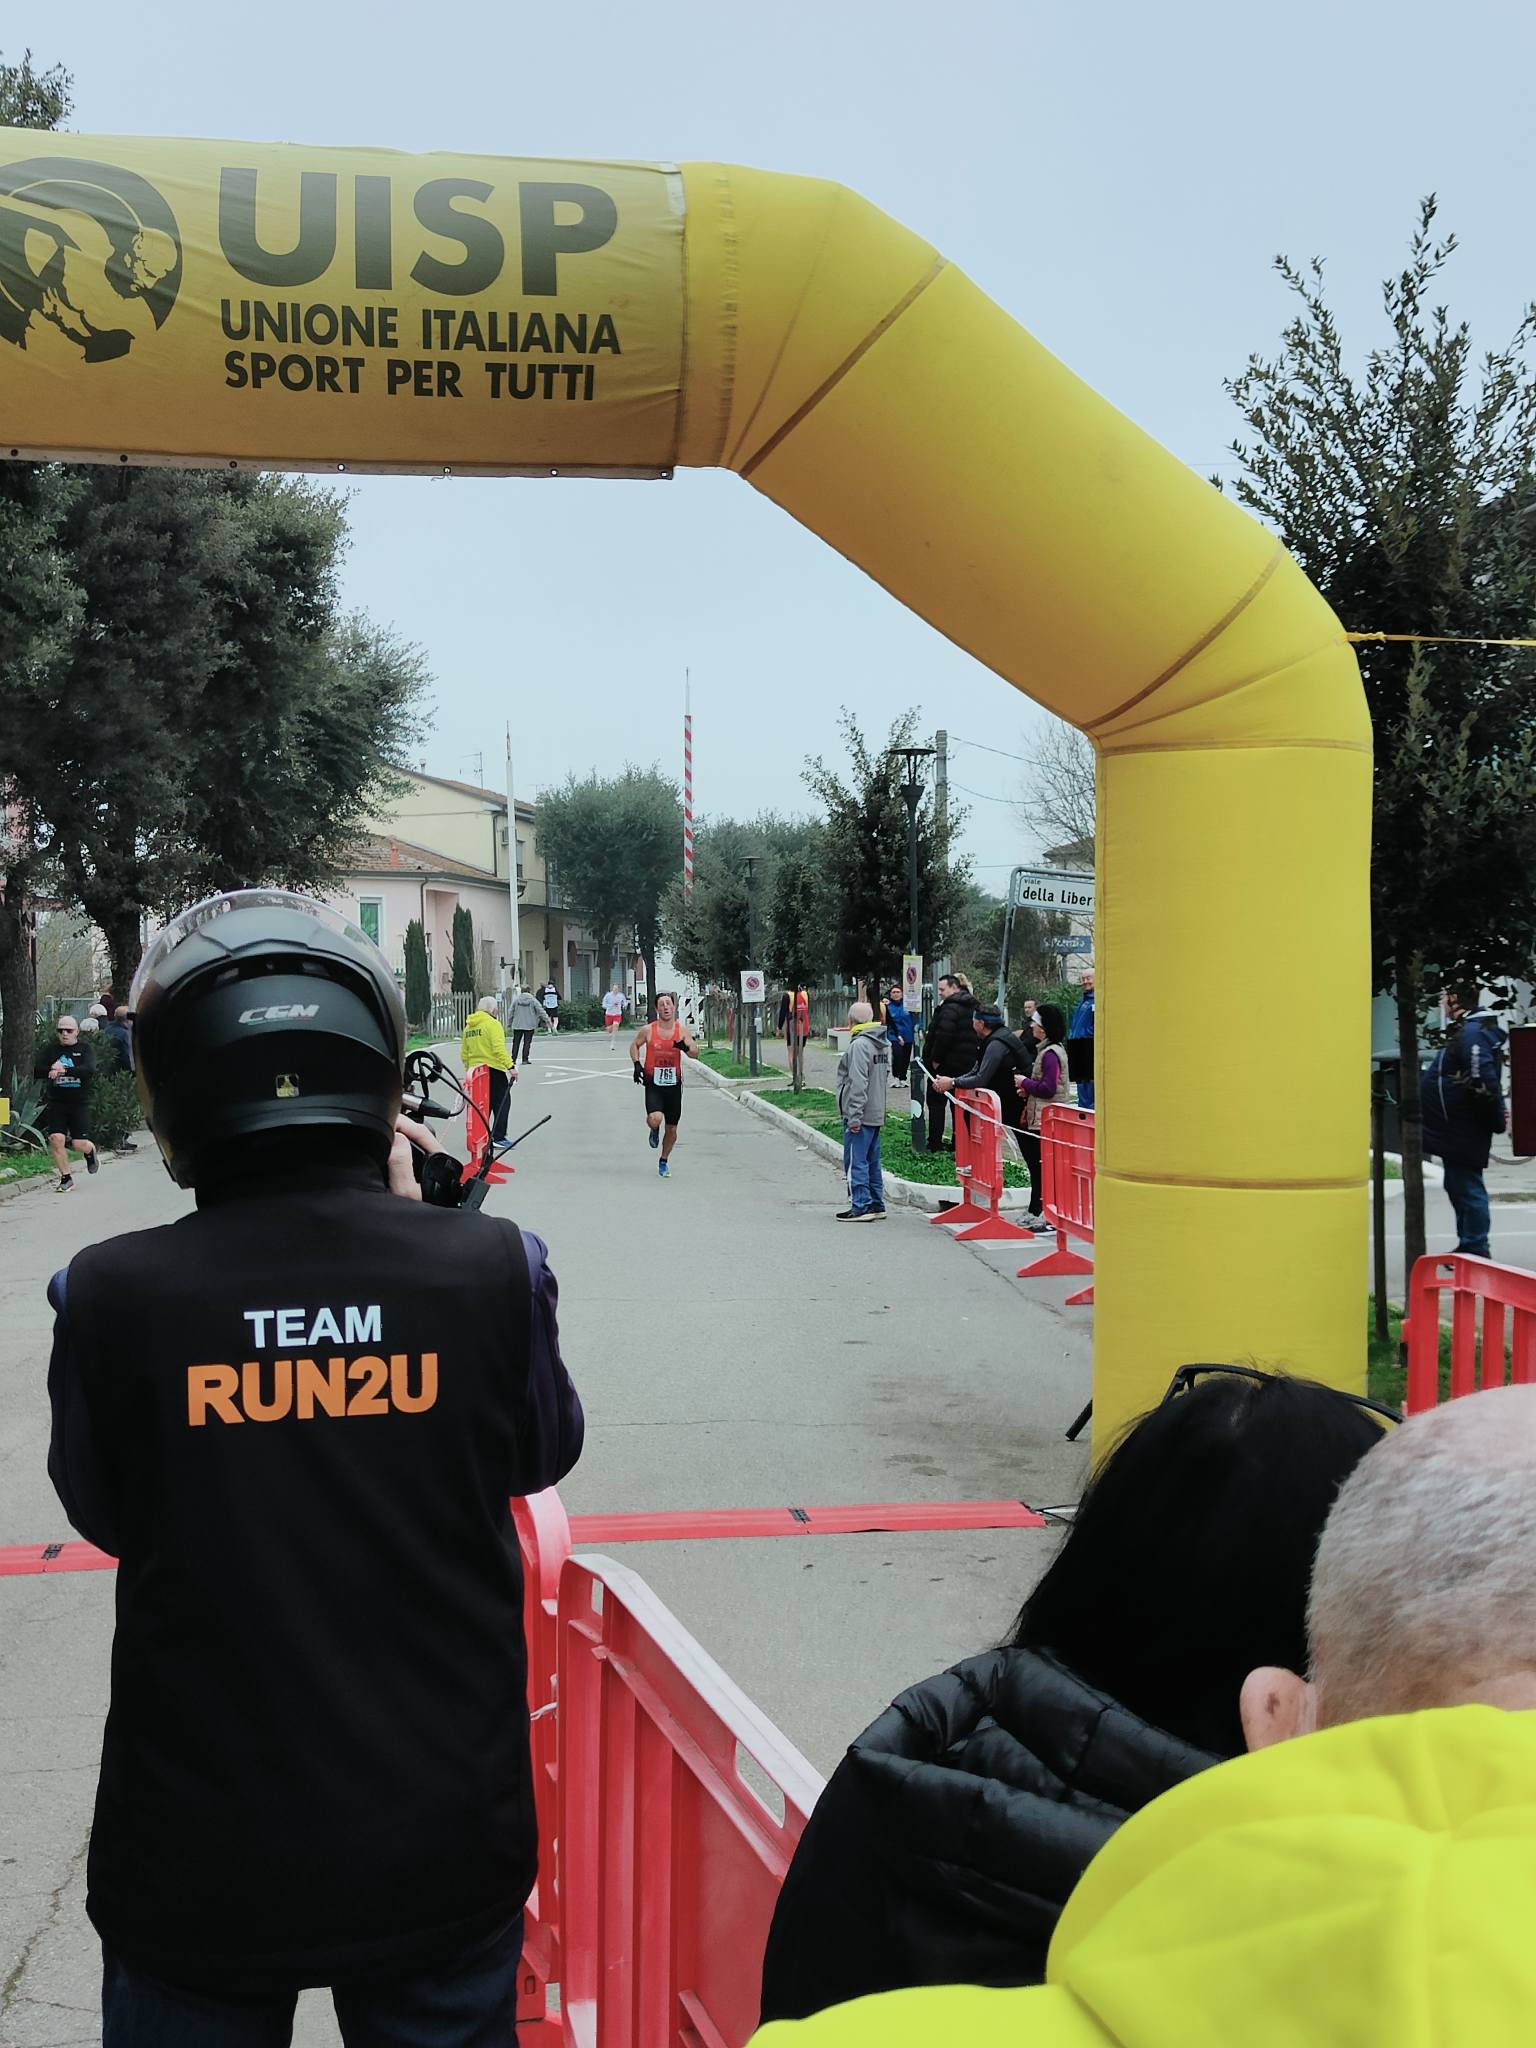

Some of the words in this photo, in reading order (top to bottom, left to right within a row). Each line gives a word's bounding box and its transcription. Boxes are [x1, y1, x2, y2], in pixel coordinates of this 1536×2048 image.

[219, 167, 618, 297] UISP
[220, 299, 398, 348] UNIONE
[421, 308, 622, 355] ITALIANA
[224, 351, 365, 394] SPORT
[387, 359, 464, 398] PER
[485, 363, 595, 401] TUTTI
[1023, 886, 1054, 902] della
[1061, 890, 1095, 907] Liber
[659, 1068, 673, 1079] 765
[244, 1305, 382, 1348] TEAM
[187, 1353, 438, 1427] RUN2U
